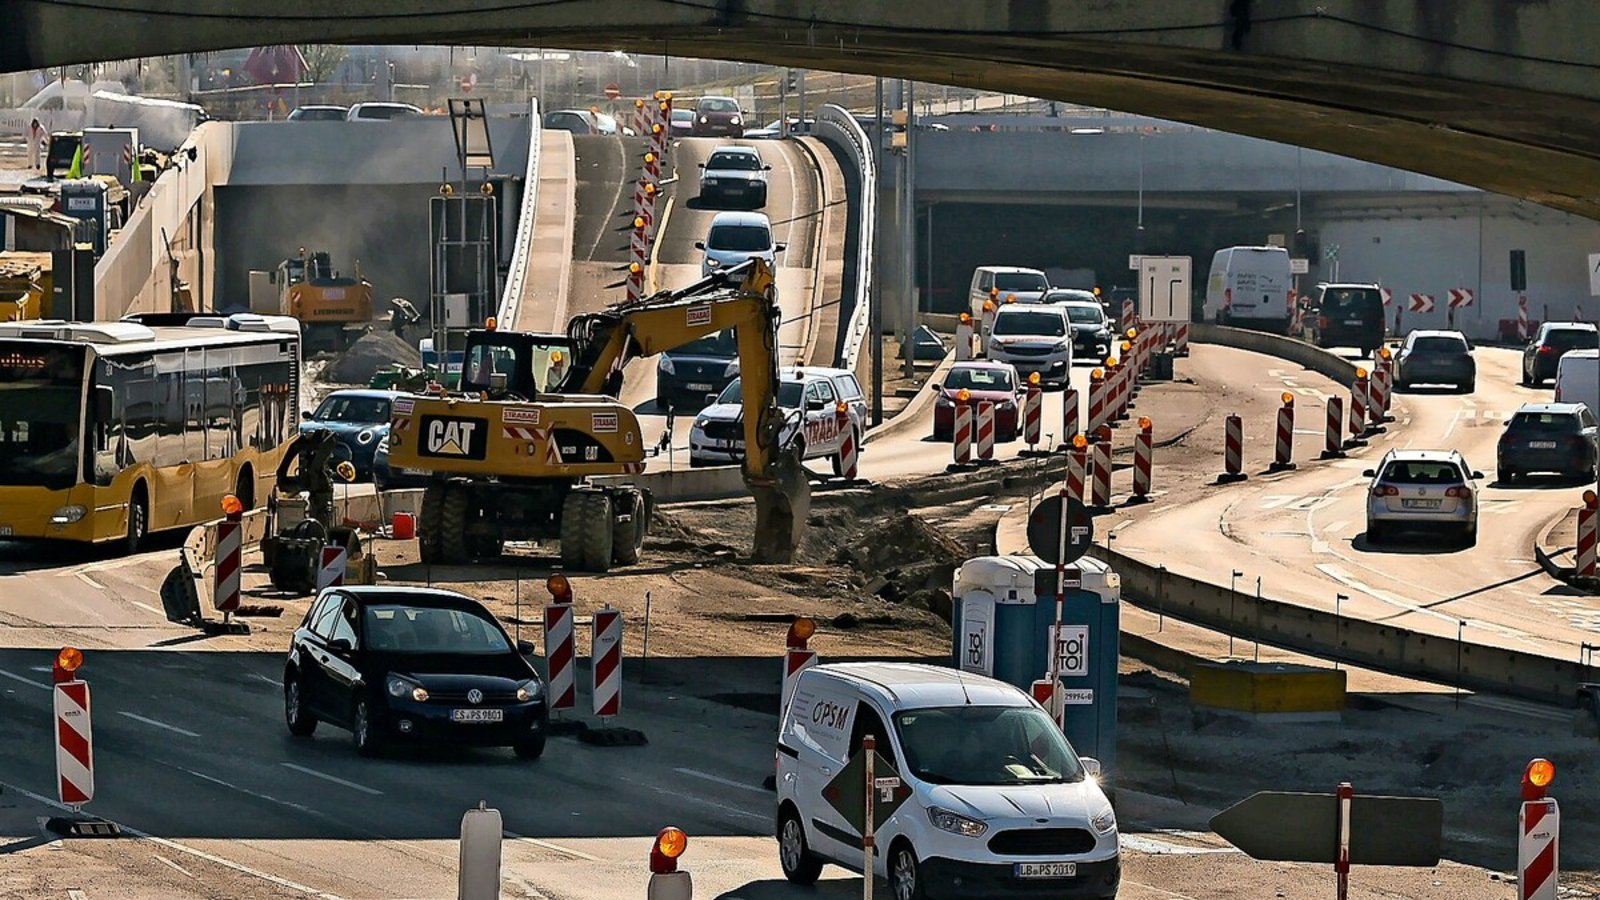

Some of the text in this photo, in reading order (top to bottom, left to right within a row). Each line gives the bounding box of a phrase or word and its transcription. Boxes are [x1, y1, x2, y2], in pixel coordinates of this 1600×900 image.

[504, 411, 539, 421] STRABAG
[428, 419, 476, 455] CAT
[1059, 655, 1083, 671] TOI
